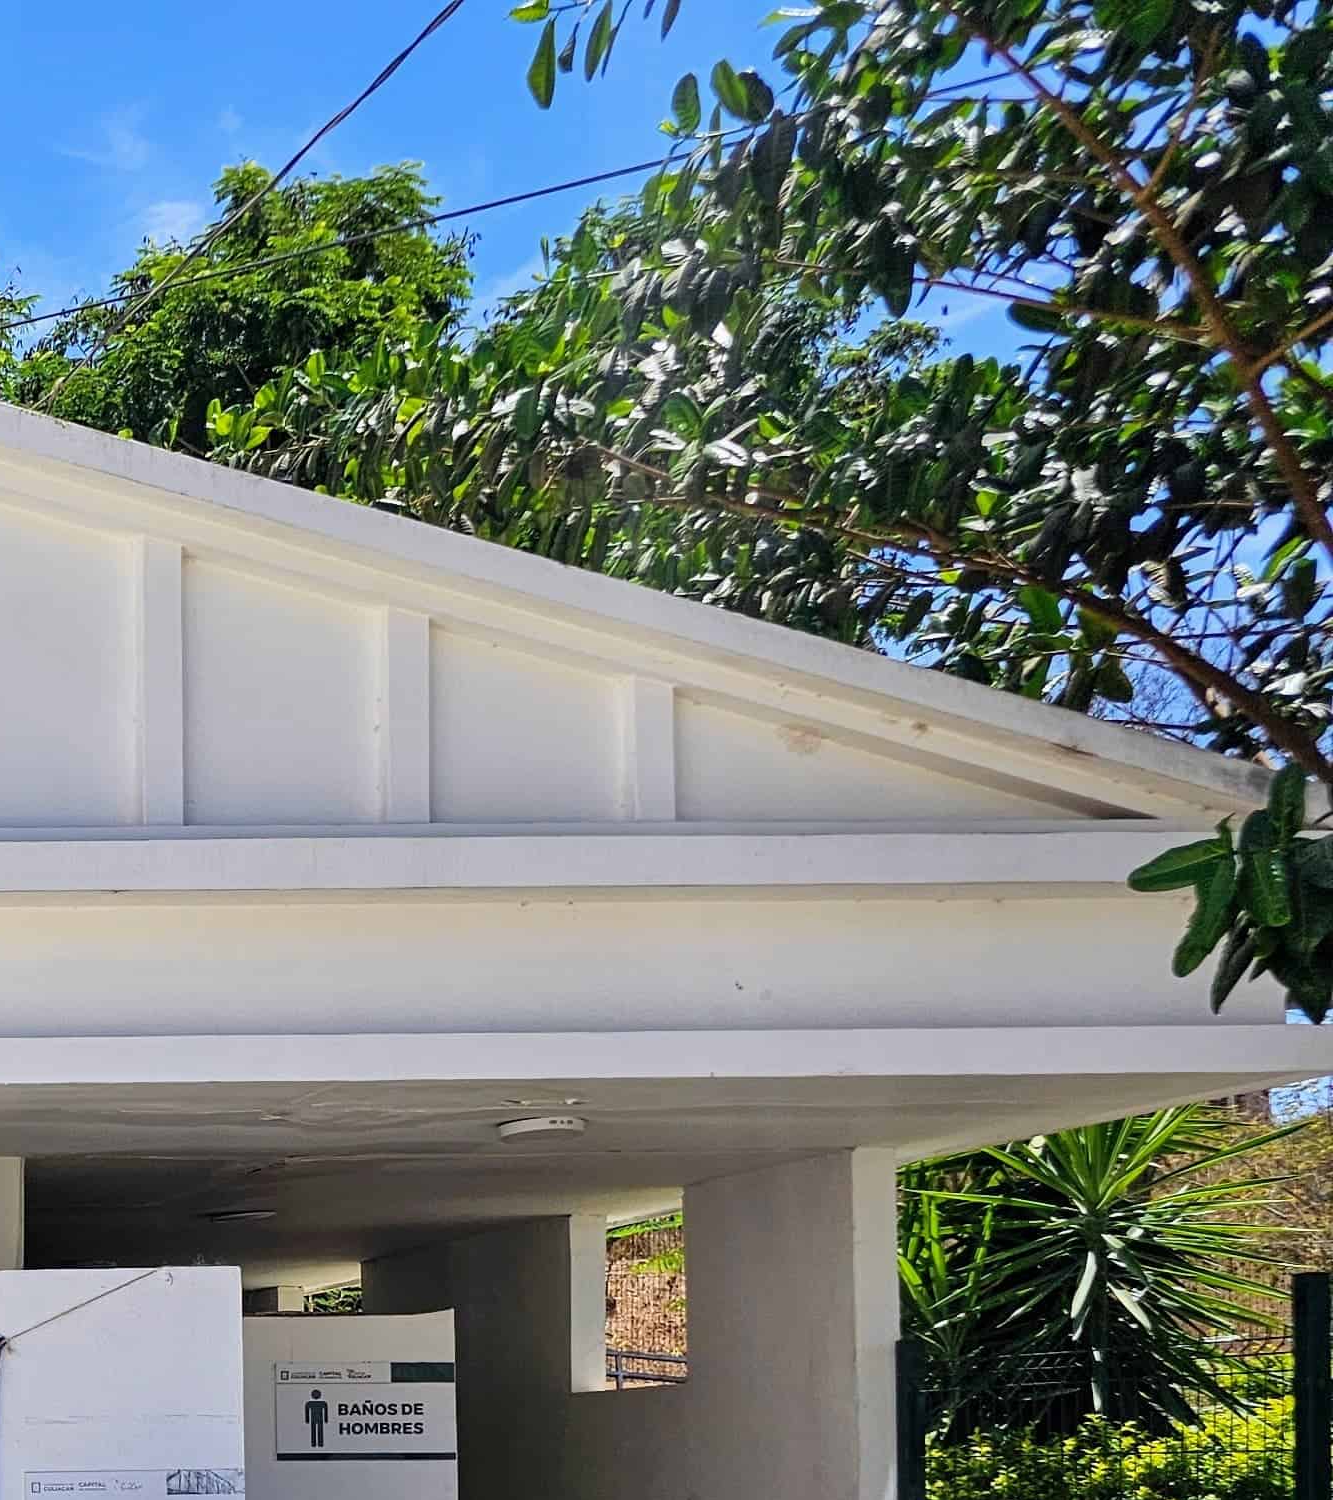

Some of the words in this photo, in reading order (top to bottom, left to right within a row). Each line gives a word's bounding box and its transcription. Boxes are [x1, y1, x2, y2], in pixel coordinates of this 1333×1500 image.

[337, 1400, 398, 1416] BAÑOS
[401, 1403, 424, 1416] DE
[338, 1422, 424, 1436] HOMBRES
